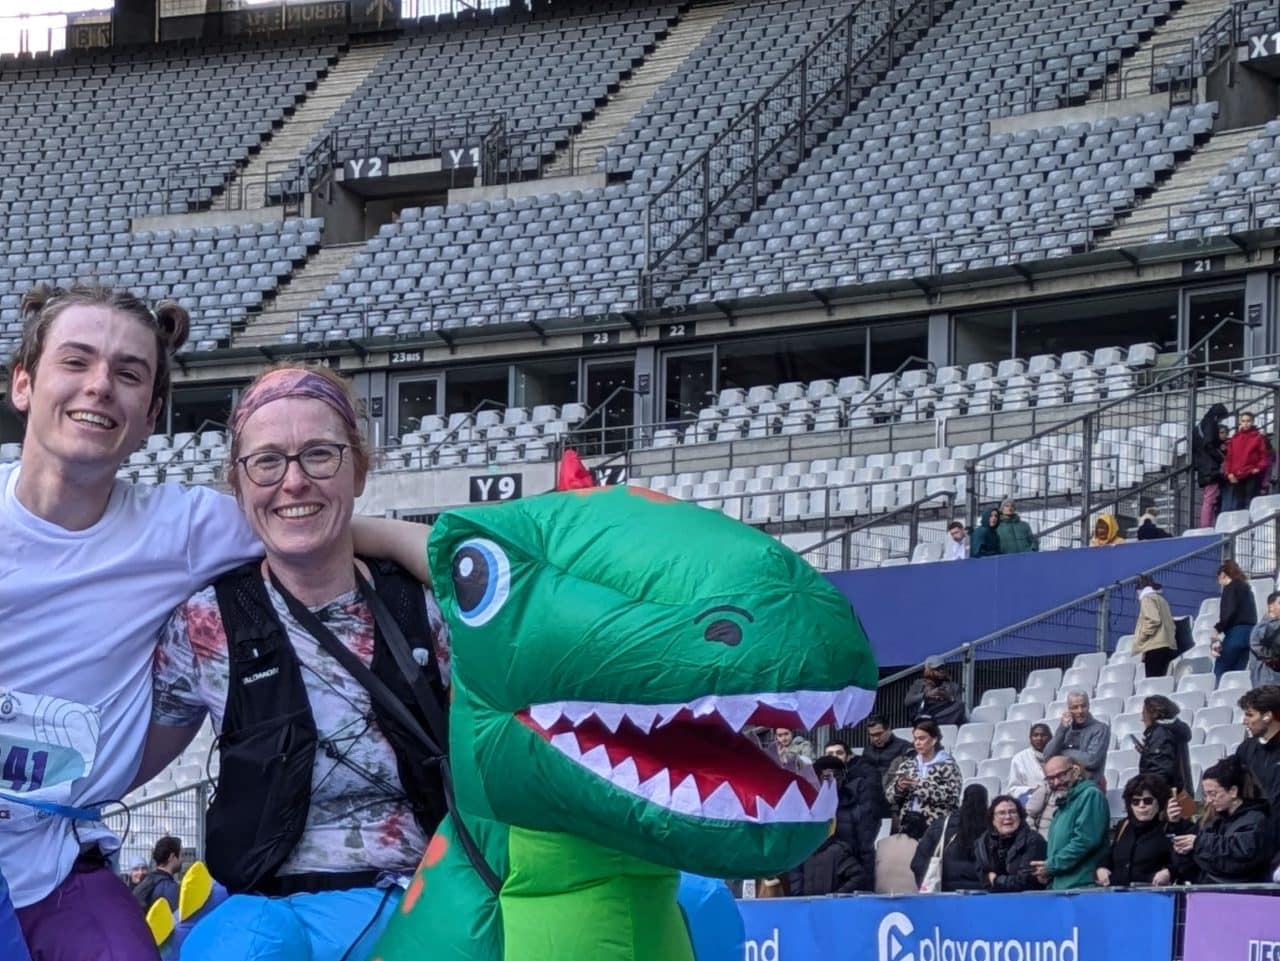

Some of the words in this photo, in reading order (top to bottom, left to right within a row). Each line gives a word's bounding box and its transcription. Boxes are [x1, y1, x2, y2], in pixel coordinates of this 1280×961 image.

[449, 147, 480, 169] Y1
[349, 157, 383, 179] Y2
[1194, 259, 1211, 272] 21
[593, 333, 609, 344] 23
[670, 325, 685, 336] 22
[477, 476, 516, 501] Y9
